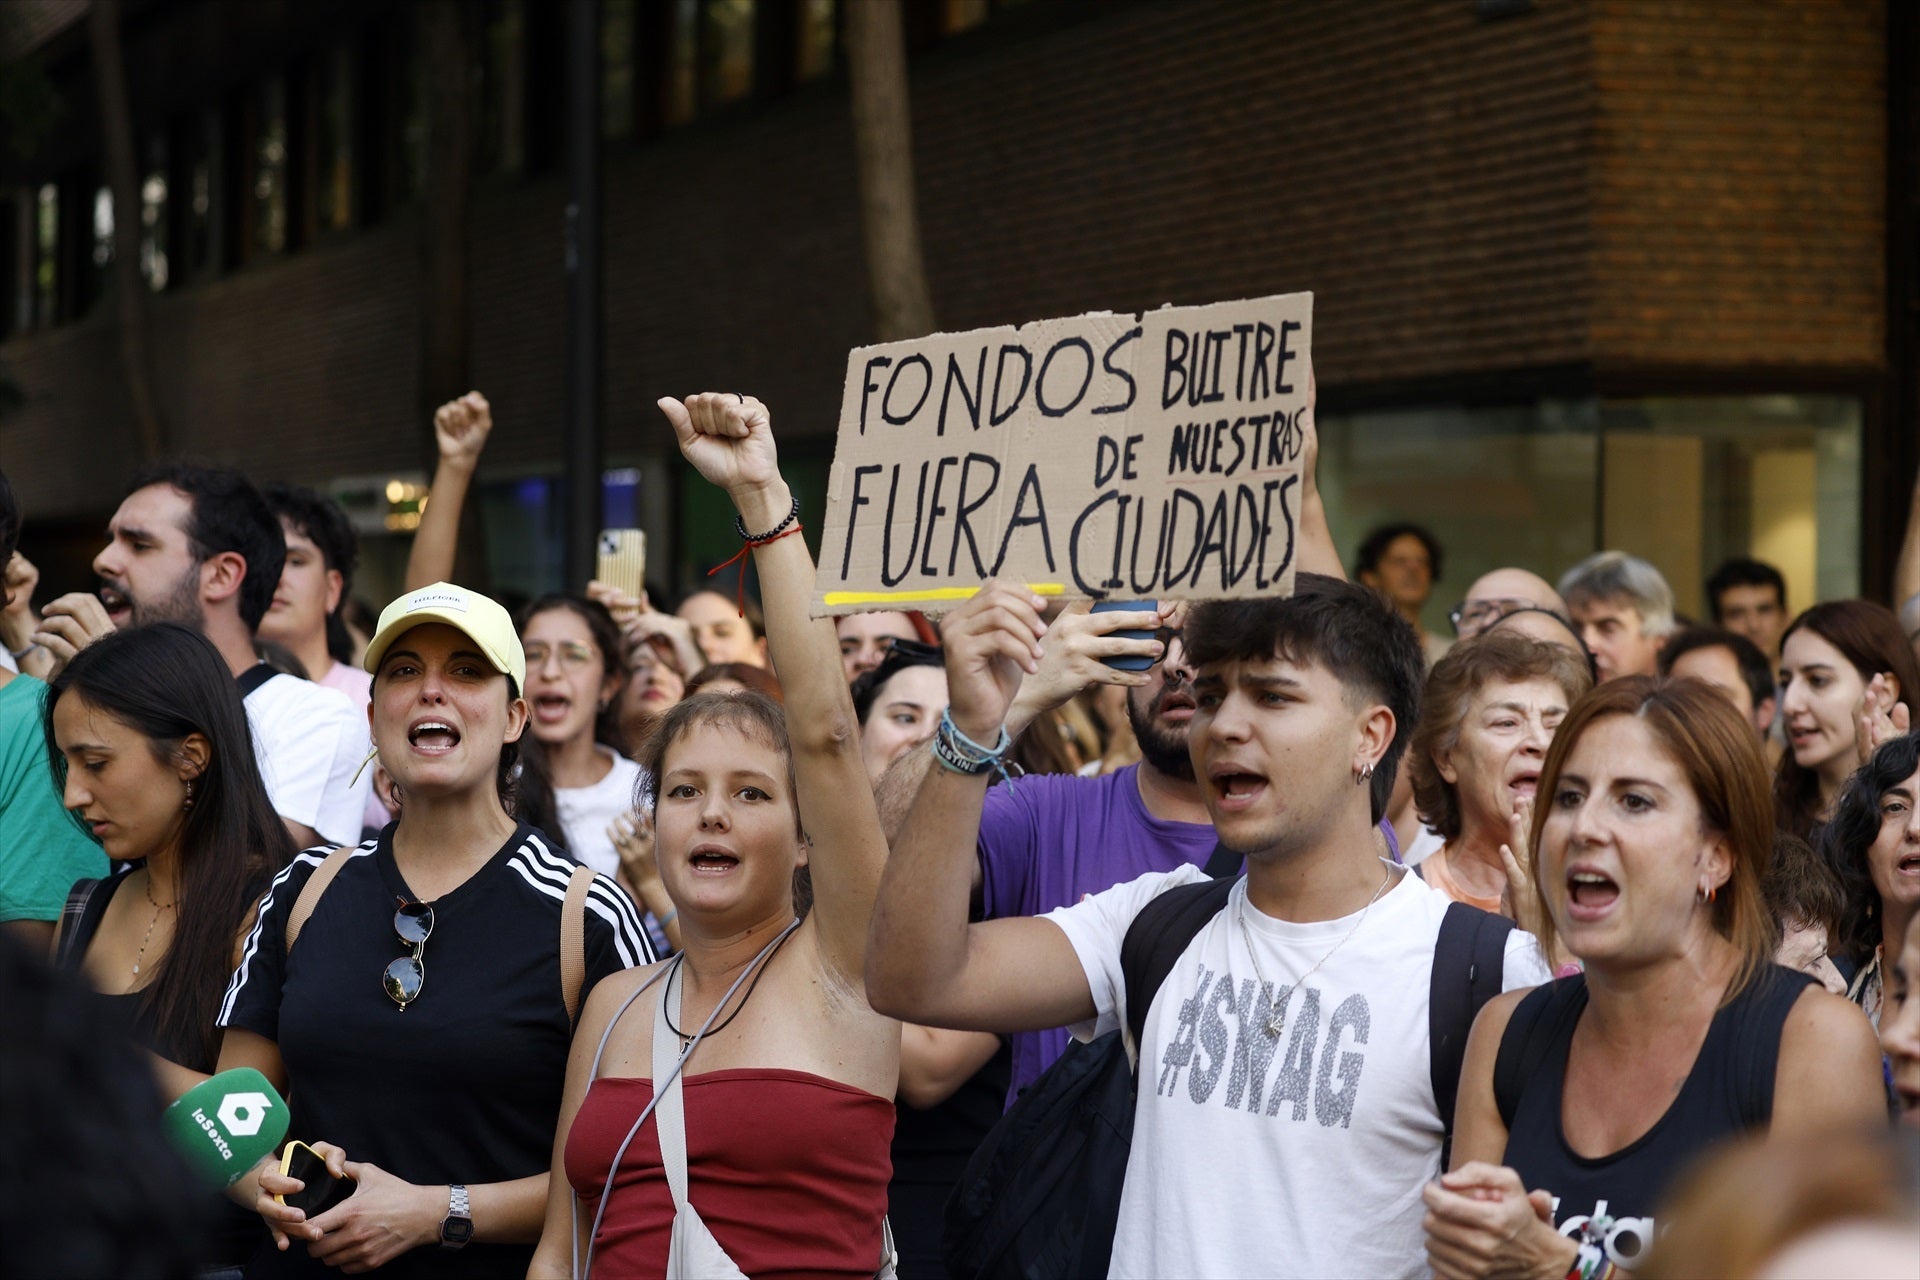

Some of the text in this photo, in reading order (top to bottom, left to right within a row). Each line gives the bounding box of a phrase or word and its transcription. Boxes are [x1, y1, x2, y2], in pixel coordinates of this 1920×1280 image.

[860, 321, 1302, 436] FONDOS BUITRE
[1094, 406, 1306, 488] DE NUESTRAS
[841, 452, 1056, 588] FUERA
[1069, 474, 1299, 598] CIUDADES
[1157, 963, 1371, 1129] #SWAG
[191, 1108, 233, 1160] laSexta
